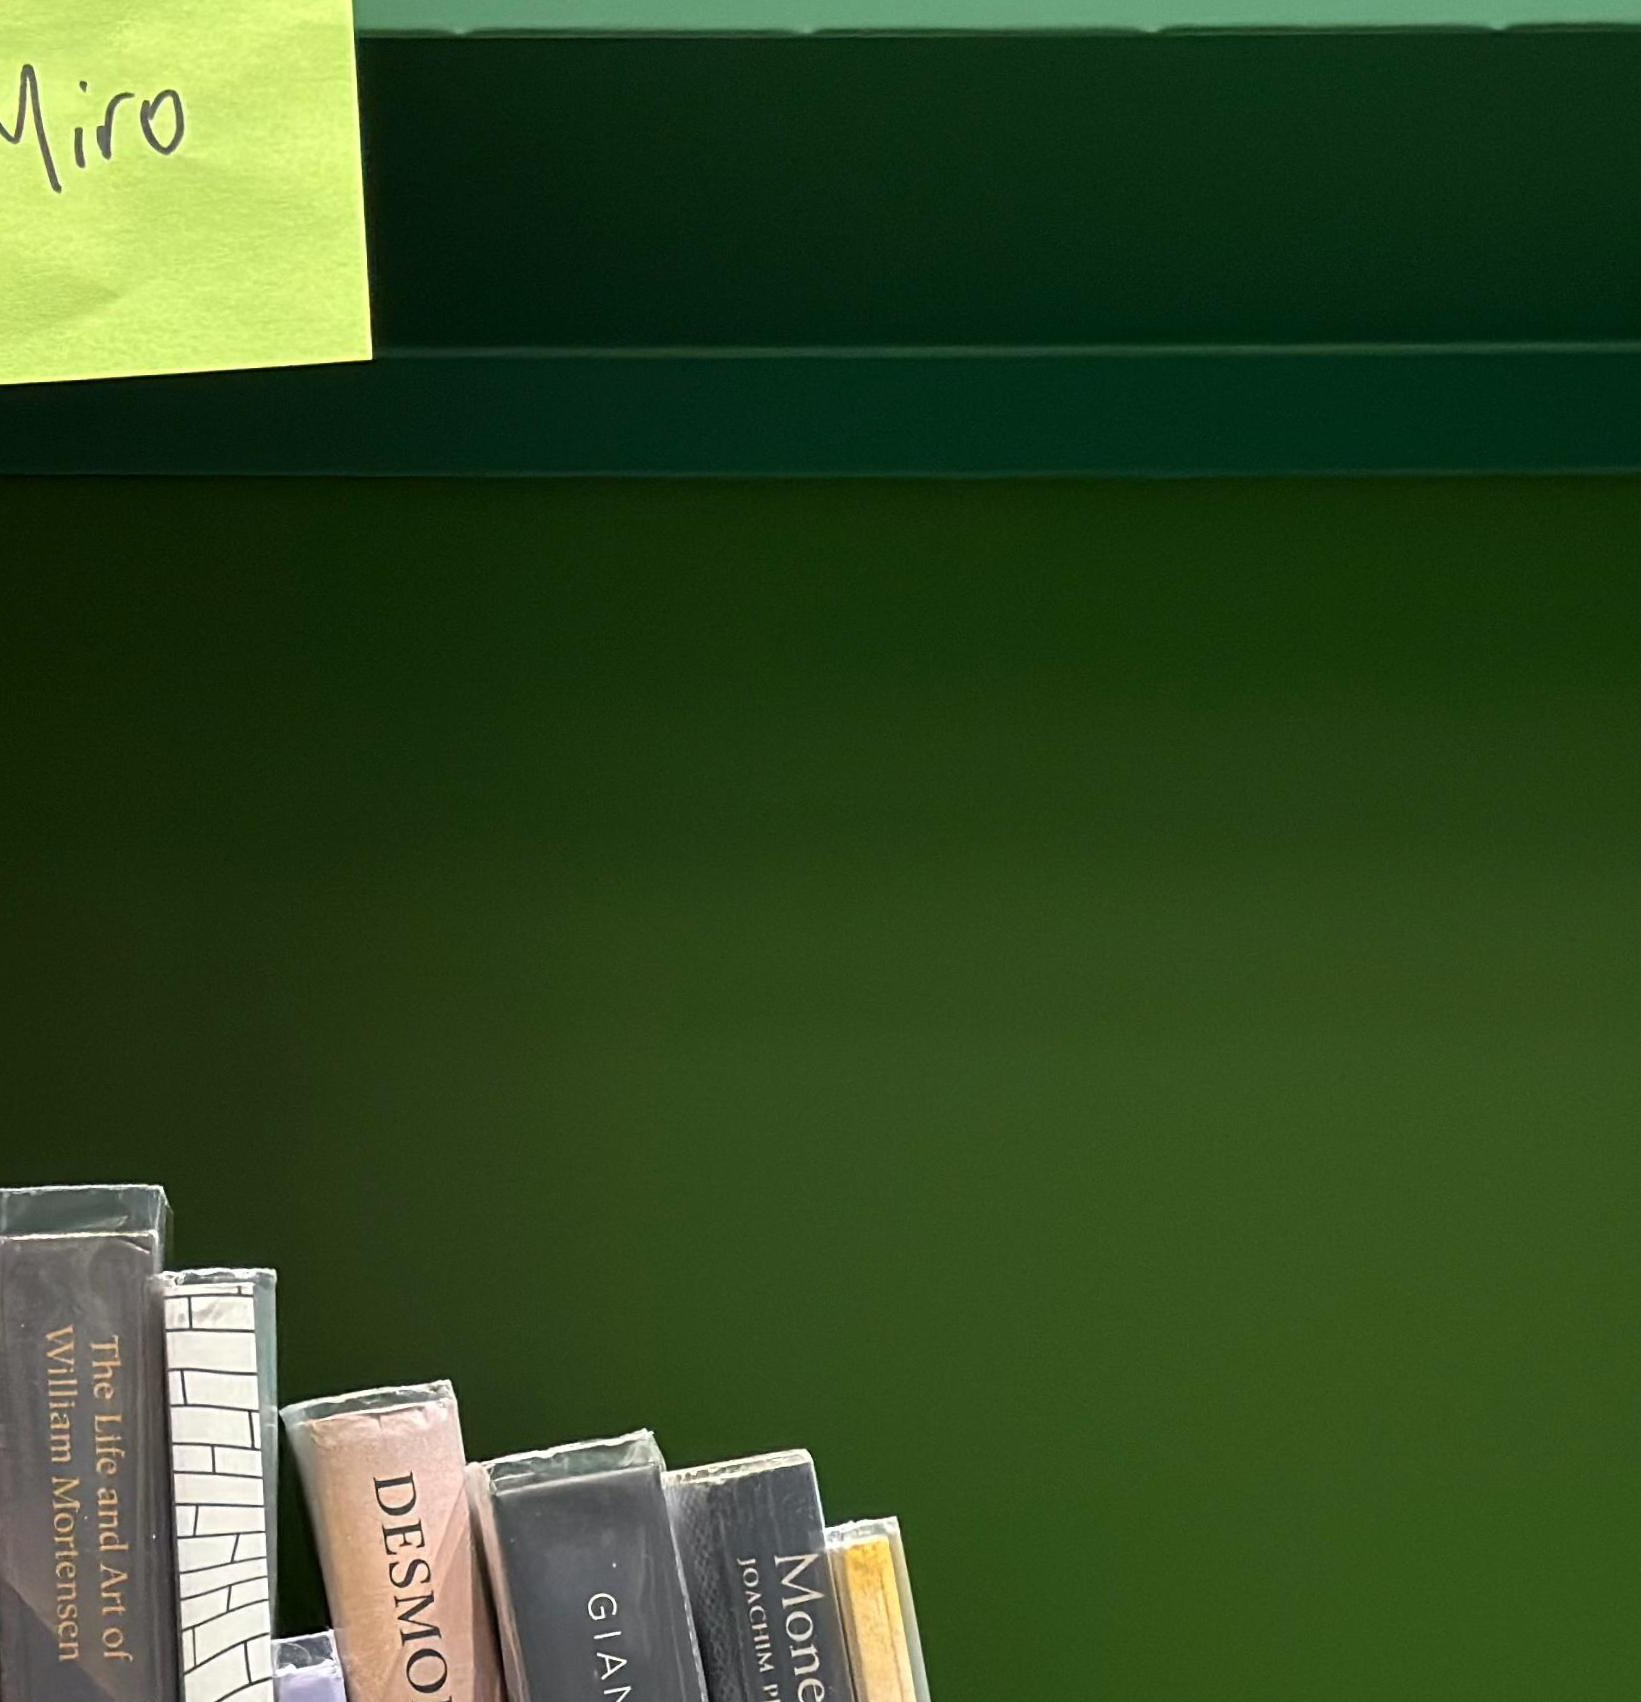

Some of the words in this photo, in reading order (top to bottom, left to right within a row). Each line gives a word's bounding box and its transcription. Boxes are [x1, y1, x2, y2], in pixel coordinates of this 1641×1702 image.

[44, 1324, 79, 1464] William
[91, 1335, 122, 1405] The
[94, 1413, 126, 1475] Life
[97, 1489, 128, 1551] and
[50, 1475, 84, 1662] Mortensen
[99, 1565, 129, 1617] Art
[102, 1627, 133, 1662] of
[736, 1556, 778, 1674] JOACHIM
